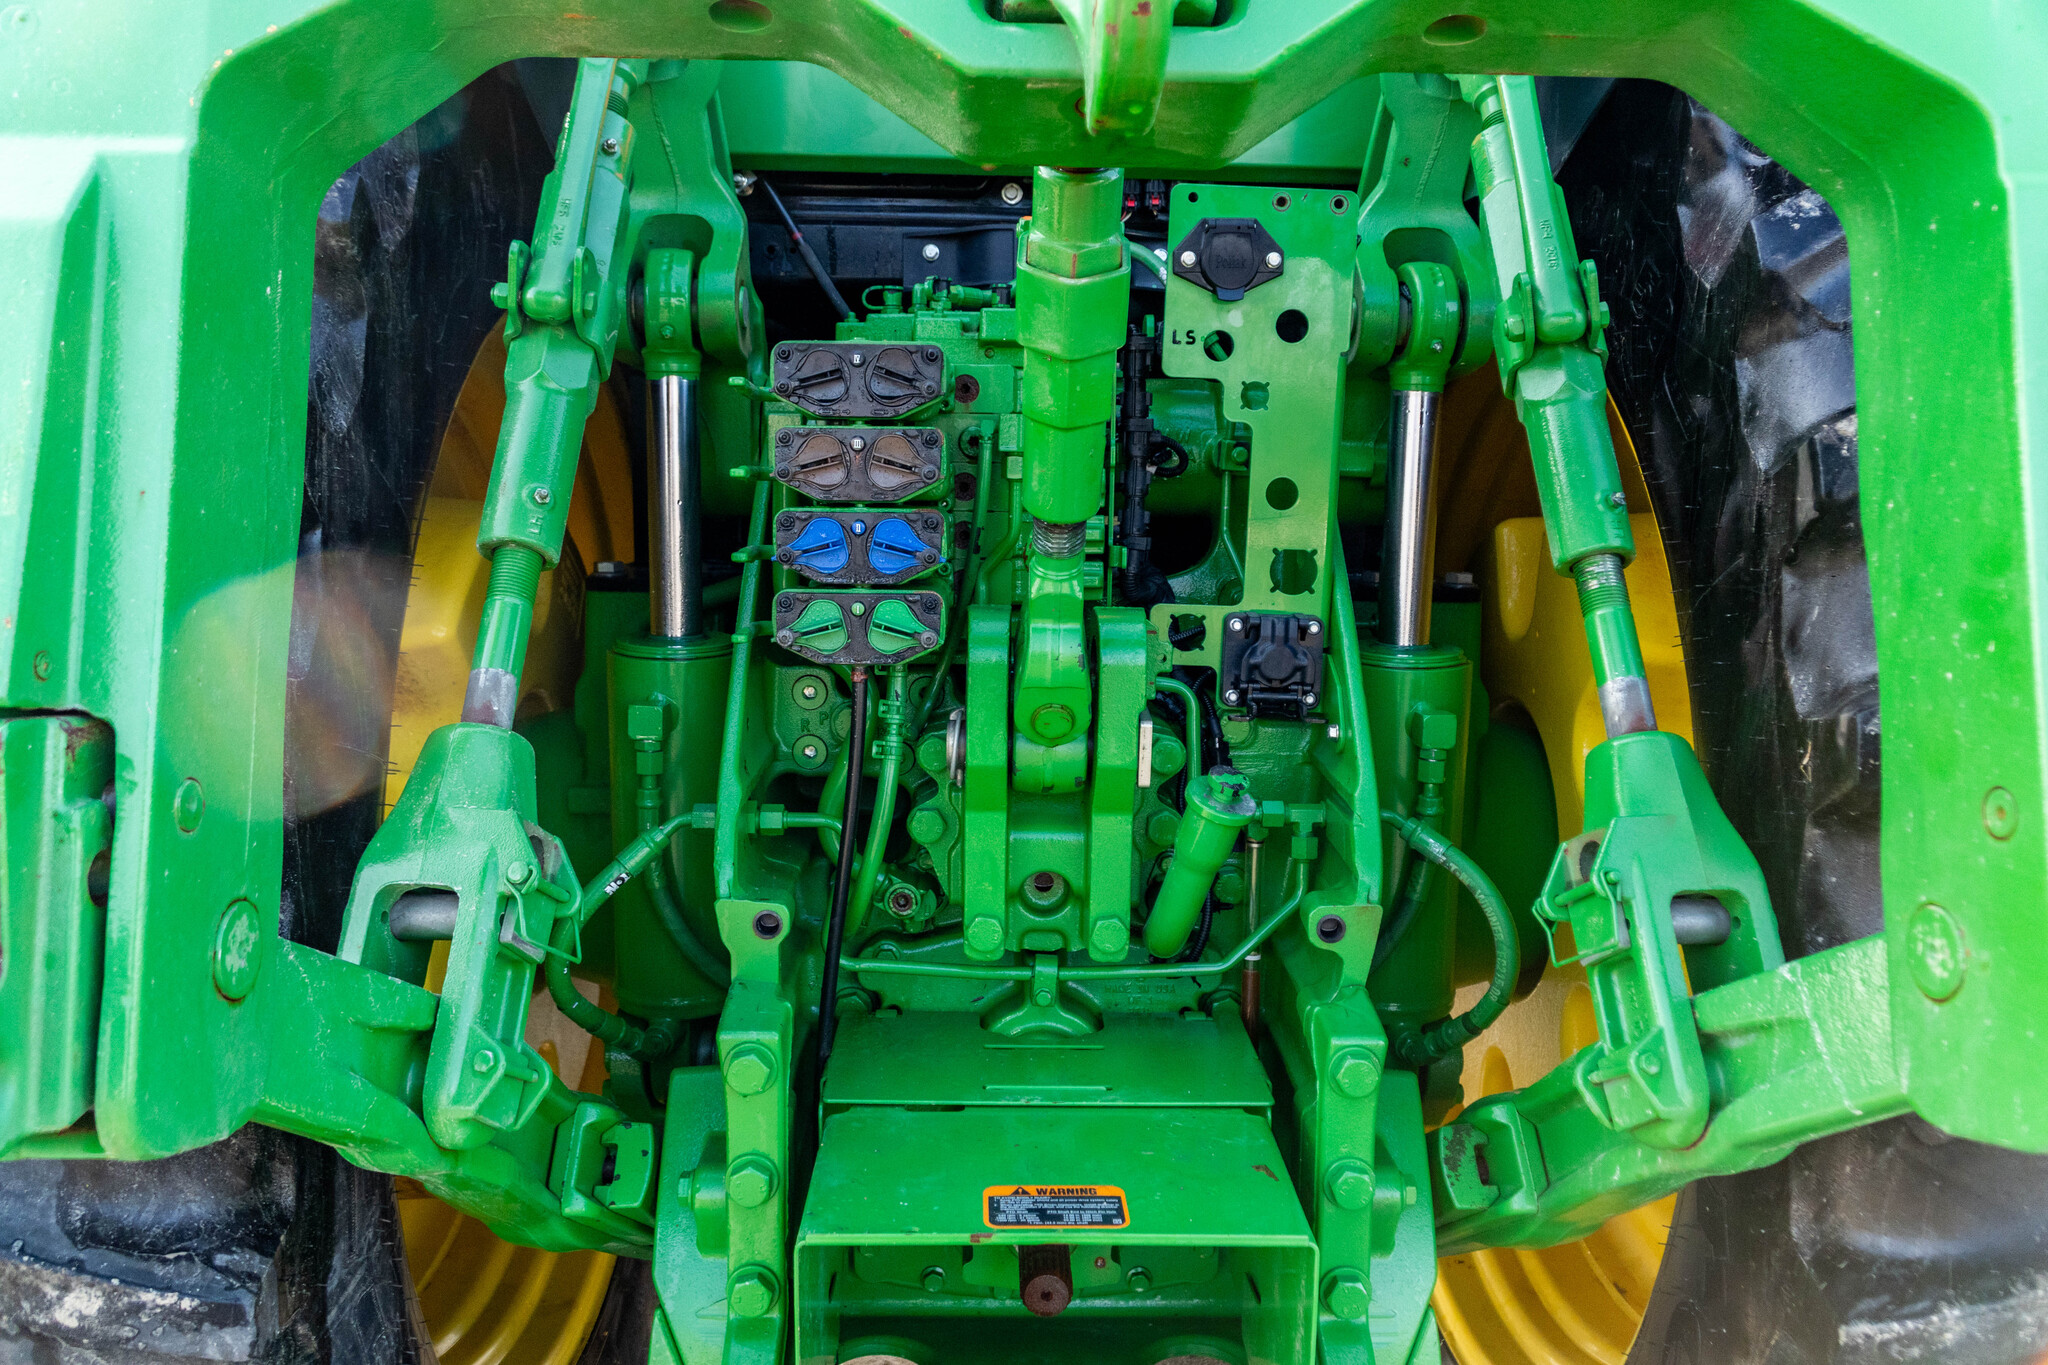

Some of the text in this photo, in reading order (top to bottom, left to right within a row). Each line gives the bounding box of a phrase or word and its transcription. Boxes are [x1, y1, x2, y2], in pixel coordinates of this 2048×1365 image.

[1172, 329, 1197, 345] LS
[800, 717, 811, 733] R
[818, 710, 830, 725] P
[1035, 1187, 1098, 1196] WARNING
